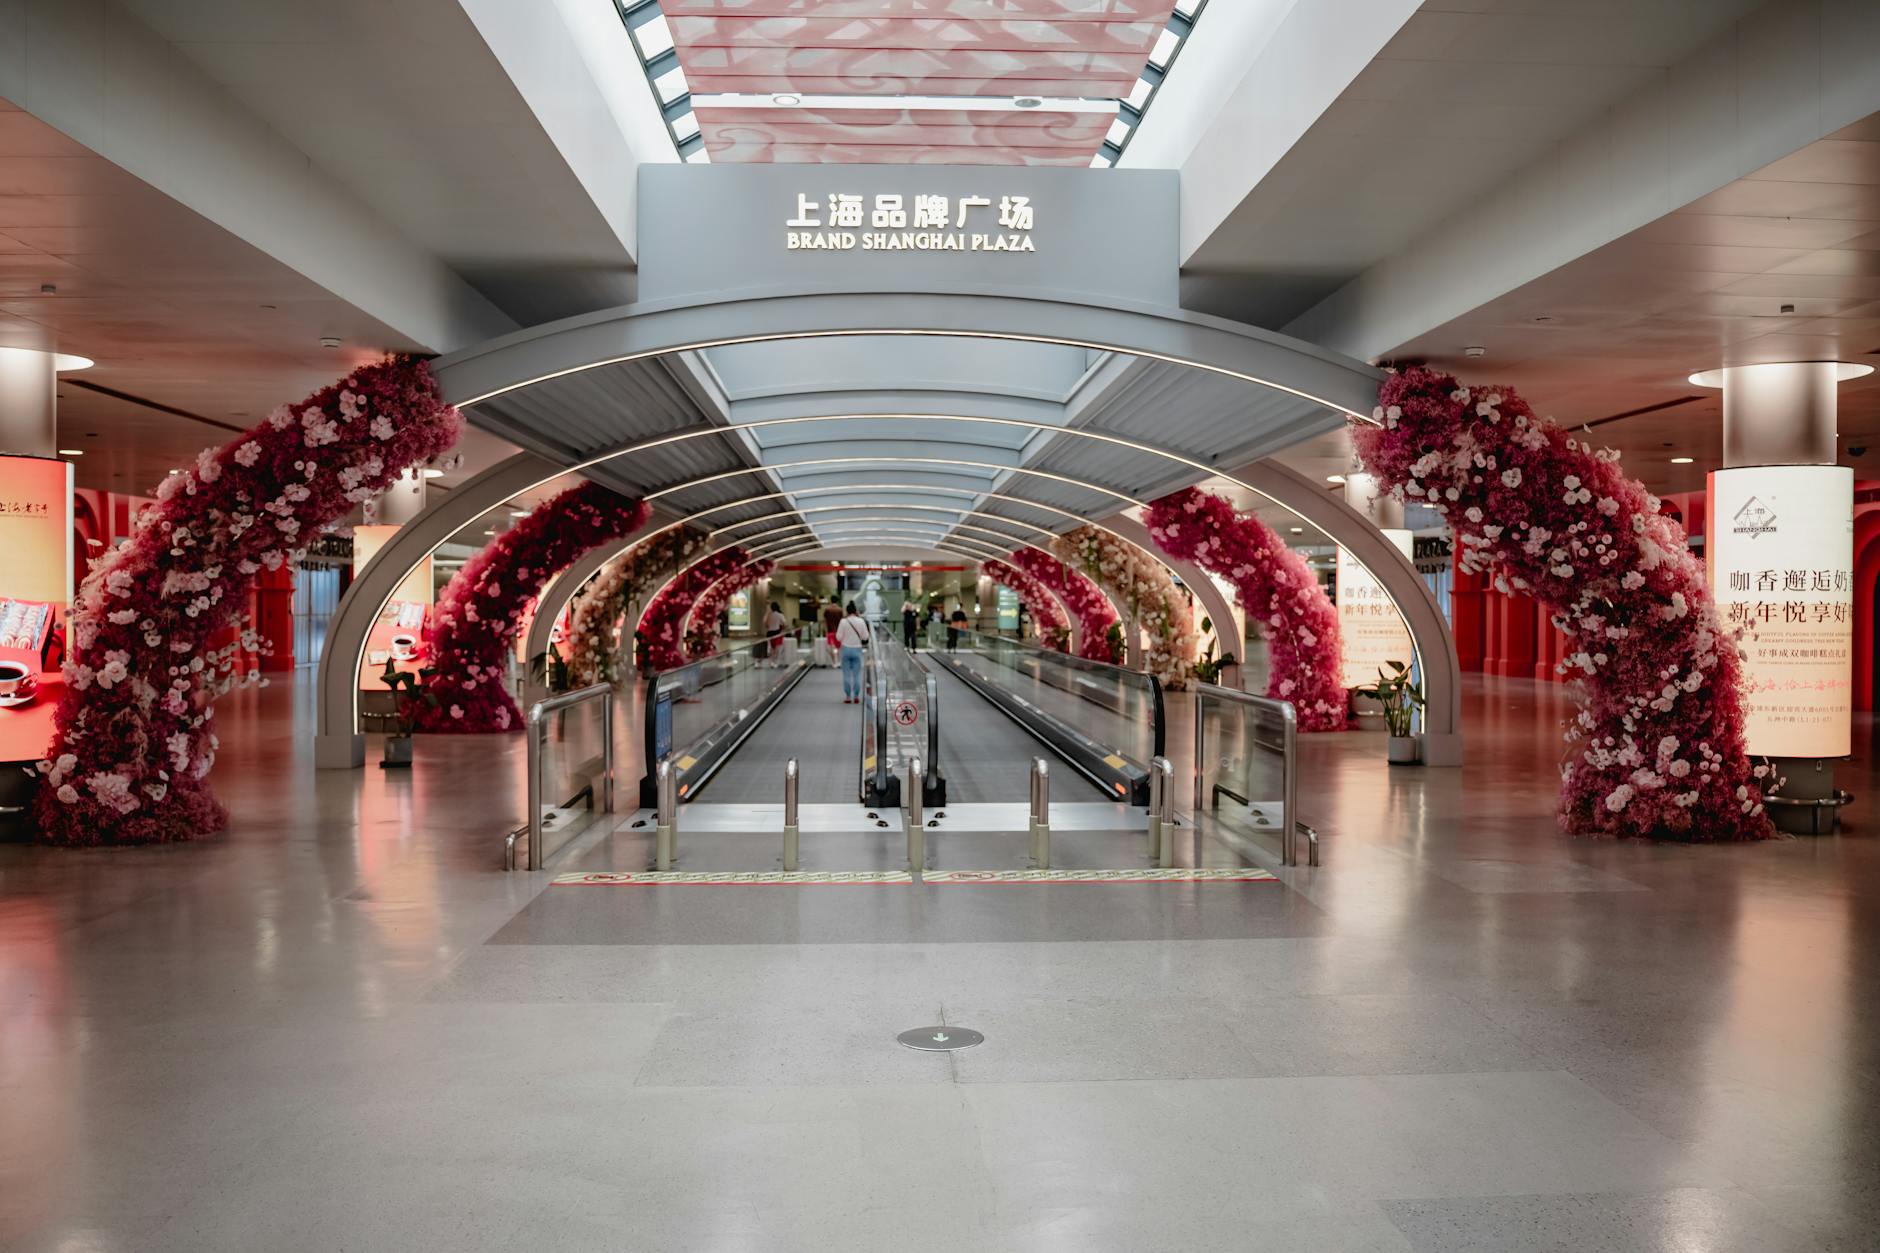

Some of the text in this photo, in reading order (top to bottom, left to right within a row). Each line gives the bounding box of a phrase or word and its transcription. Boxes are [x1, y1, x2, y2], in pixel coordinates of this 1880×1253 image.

[786, 193, 1034, 229] 上海品牌广场
[787, 233, 1035, 251] BRAND SHANGHAI PLAZA
[1729, 600, 1853, 623] 新年悦享好
